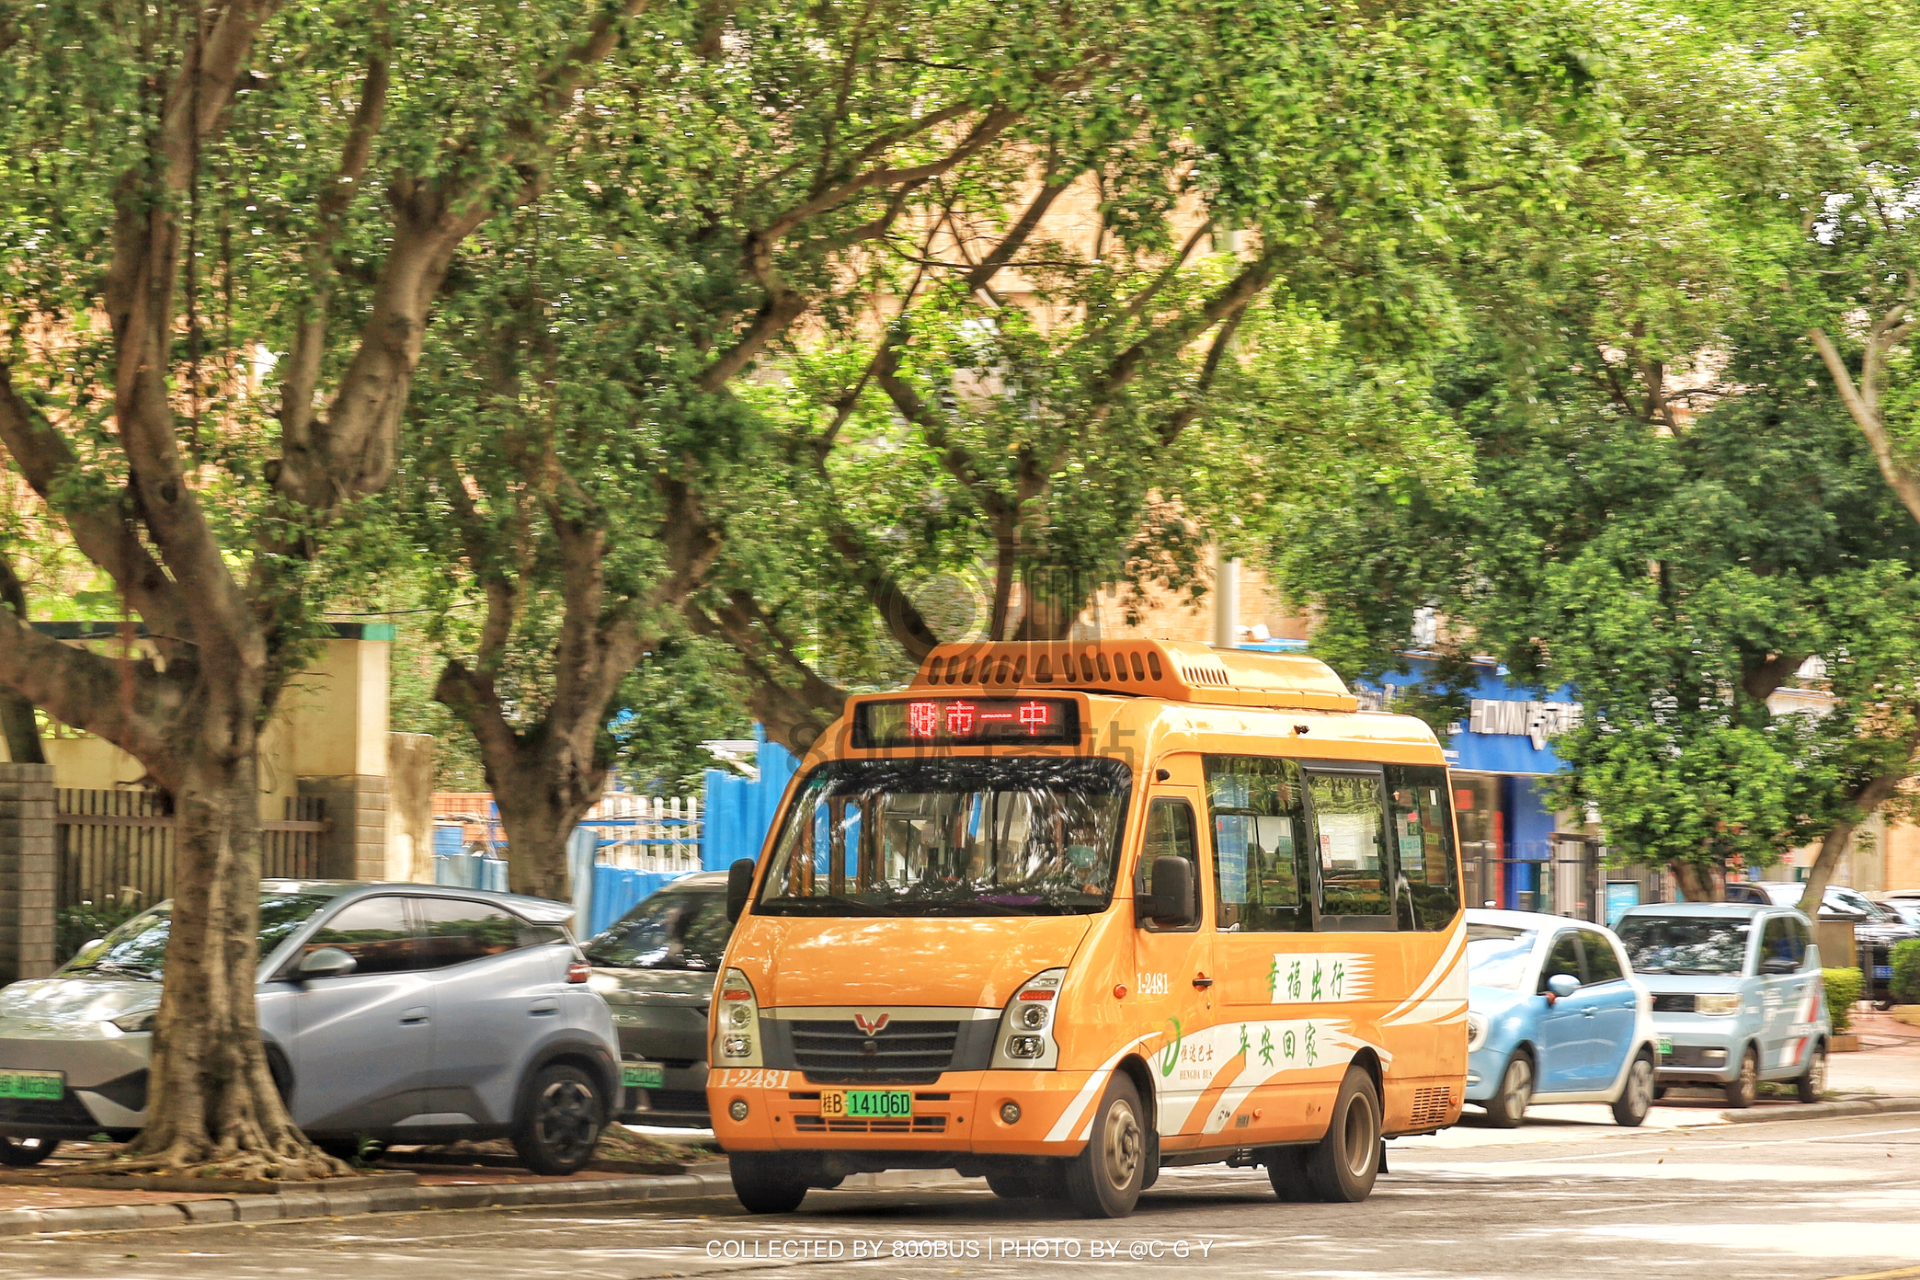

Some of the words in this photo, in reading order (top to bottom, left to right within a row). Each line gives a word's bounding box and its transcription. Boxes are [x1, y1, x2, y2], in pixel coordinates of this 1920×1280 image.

[1136, 972, 1169, 995] 1-2481
[1265, 953, 1345, 1001] 幸福出行
[1180, 1043, 1214, 1063] 恒达巴士
[1238, 1021, 1319, 1071] 平安回家
[718, 1068, 791, 1089] 1-2481
